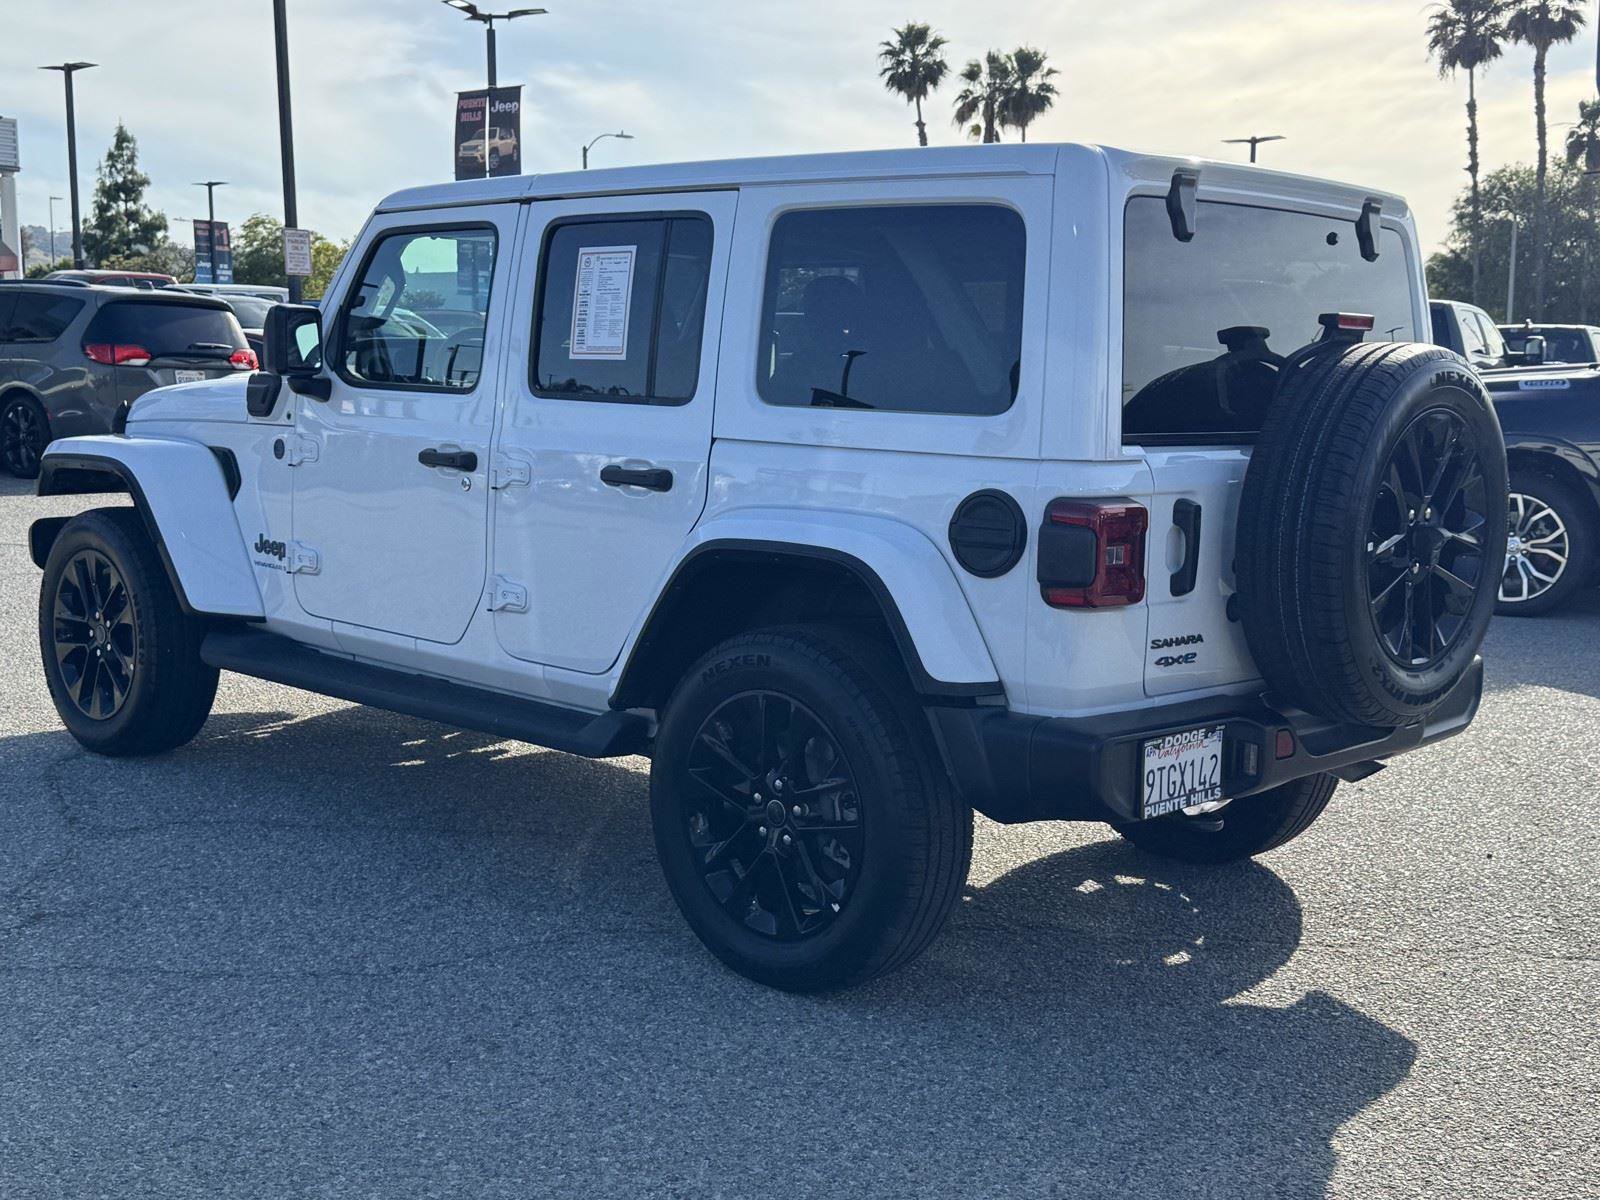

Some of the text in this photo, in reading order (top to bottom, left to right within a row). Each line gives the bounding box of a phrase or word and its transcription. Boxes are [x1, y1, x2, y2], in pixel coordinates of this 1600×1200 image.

[460, 111, 482, 121] HILLS
[491, 100, 519, 113] Jeep
[1435, 370, 1485, 401] NEXEN
[254, 533, 287, 561] Jeep
[1150, 633, 1205, 649] SAHARA
[702, 654, 771, 680] NEXEN
[1164, 728, 1206, 748] DODGE
[1157, 741, 1209, 760] California
[1144, 753, 1219, 806] 9TGX142
[1144, 787, 1222, 820] PUENTE HILLS
